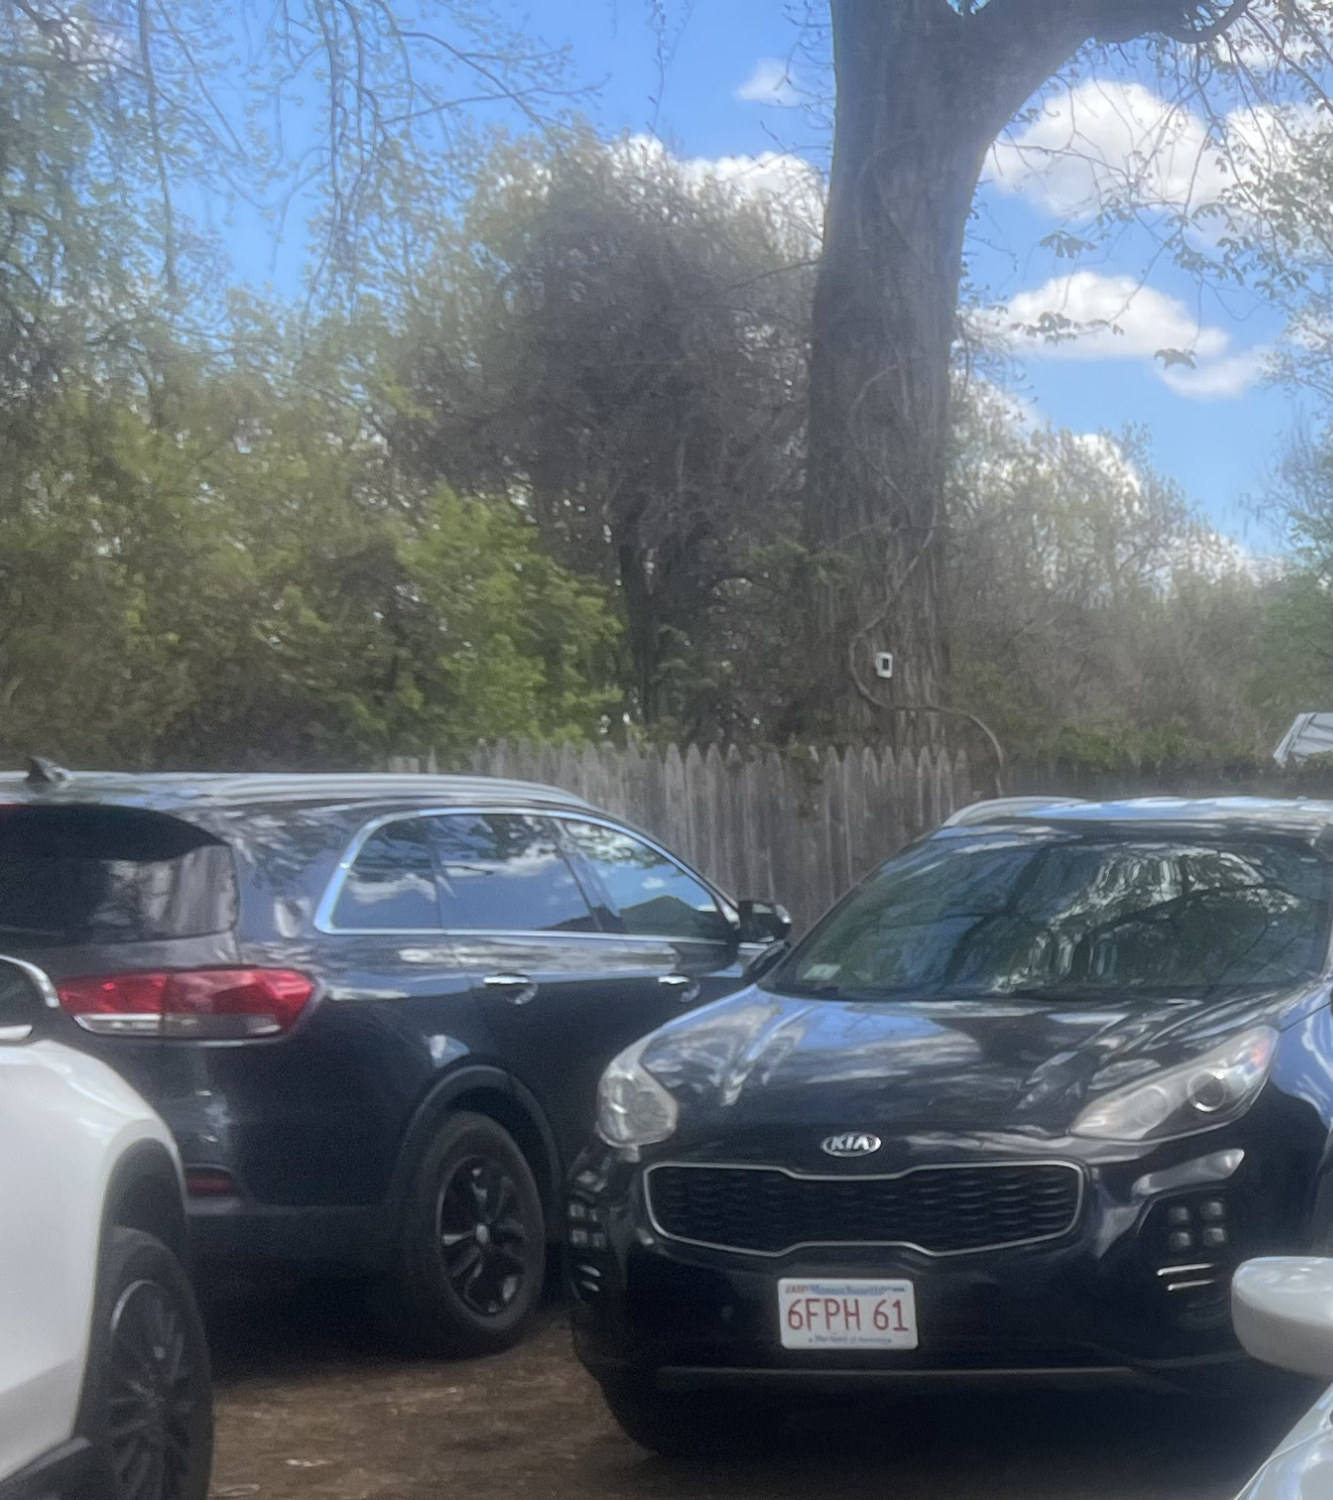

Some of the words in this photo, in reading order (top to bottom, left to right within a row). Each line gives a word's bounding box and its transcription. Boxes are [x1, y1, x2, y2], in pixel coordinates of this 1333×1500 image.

[831, 1136, 870, 1151] KIA
[787, 1298, 861, 1331] 6FPH
[873, 1299, 909, 1332] 61
